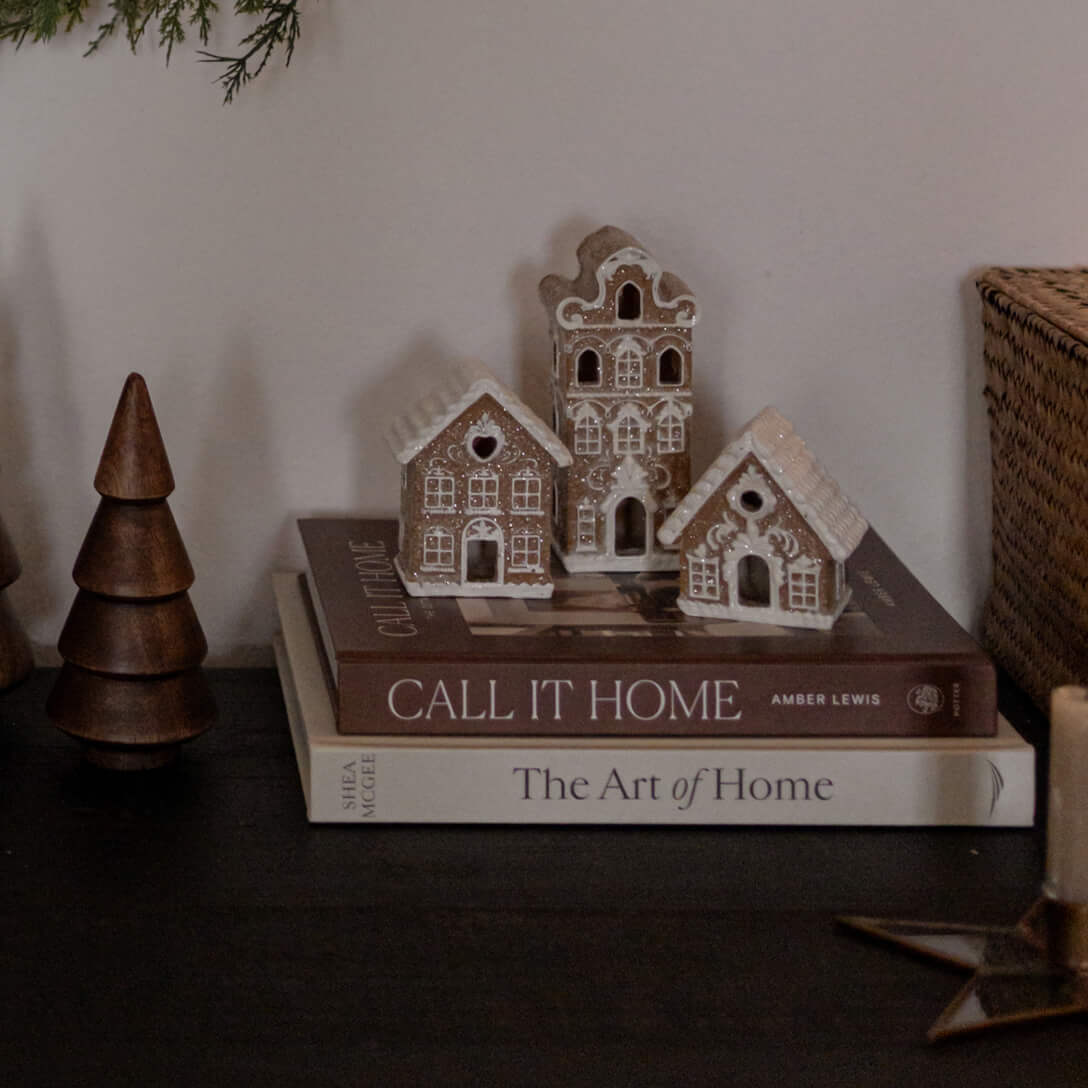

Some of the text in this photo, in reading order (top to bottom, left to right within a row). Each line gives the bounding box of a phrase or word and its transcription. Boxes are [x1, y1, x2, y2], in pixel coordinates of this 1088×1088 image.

[348, 540, 418, 637] CALL IT HOME
[387, 678, 881, 721] CALL IT HOME AMBER LEWIS
[342, 760, 357, 810] SHEA
[361, 753, 376, 818] MCGEE
[512, 767, 835, 811] The Art of Home
